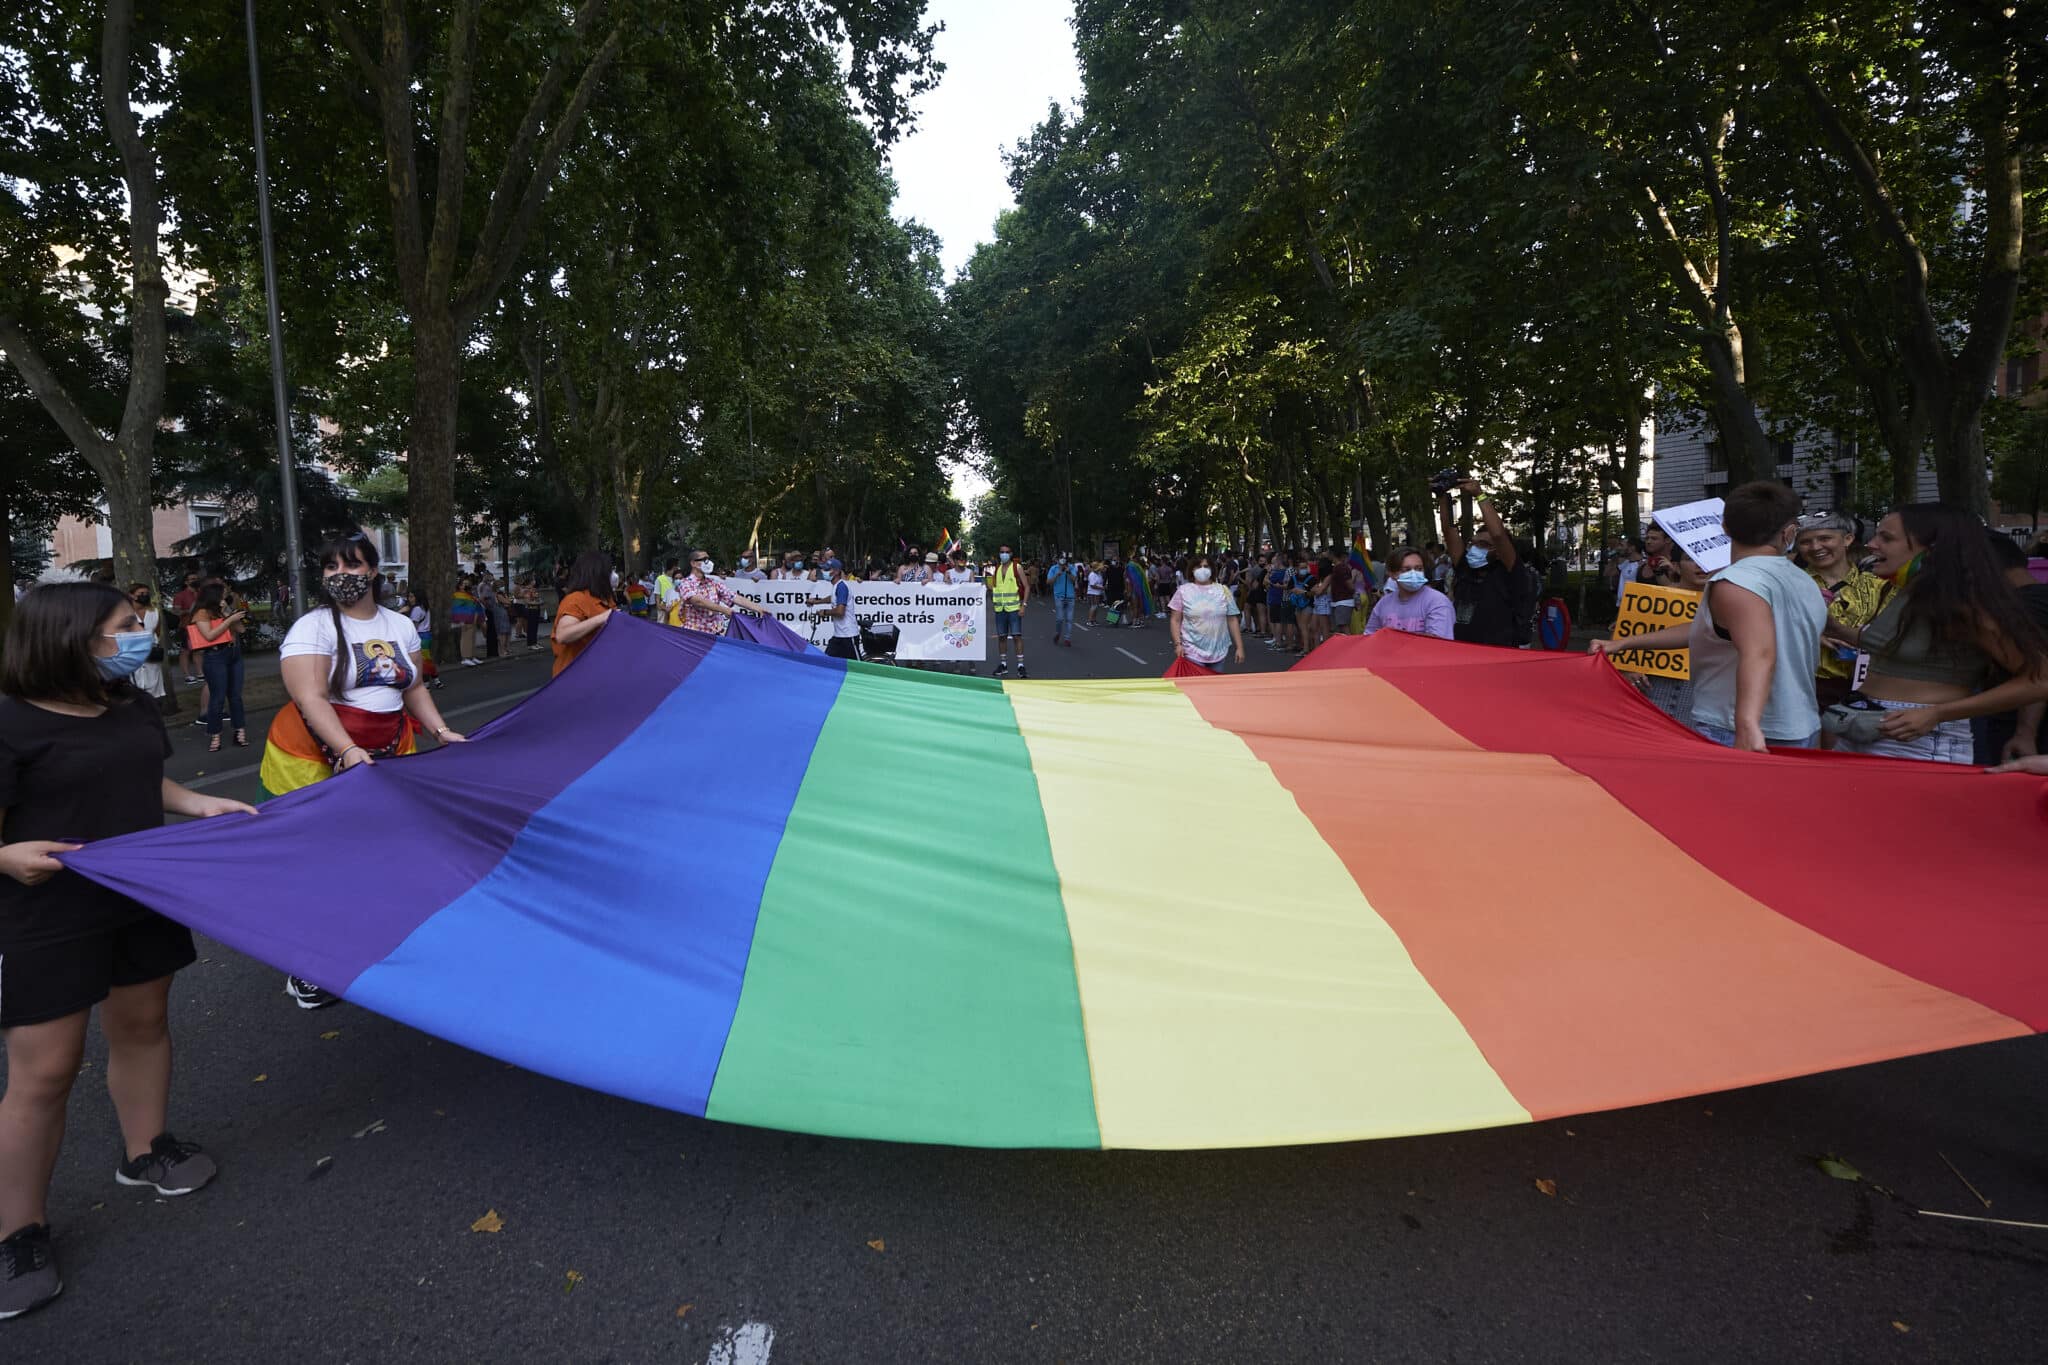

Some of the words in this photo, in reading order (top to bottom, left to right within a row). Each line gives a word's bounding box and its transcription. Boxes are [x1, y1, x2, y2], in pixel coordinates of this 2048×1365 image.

[855, 594, 911, 606] erechos
[915, 594, 983, 607] Humanos
[1625, 594, 1698, 619] TODOS
[777, 612, 795, 621] no
[898, 611, 935, 624] atrás
